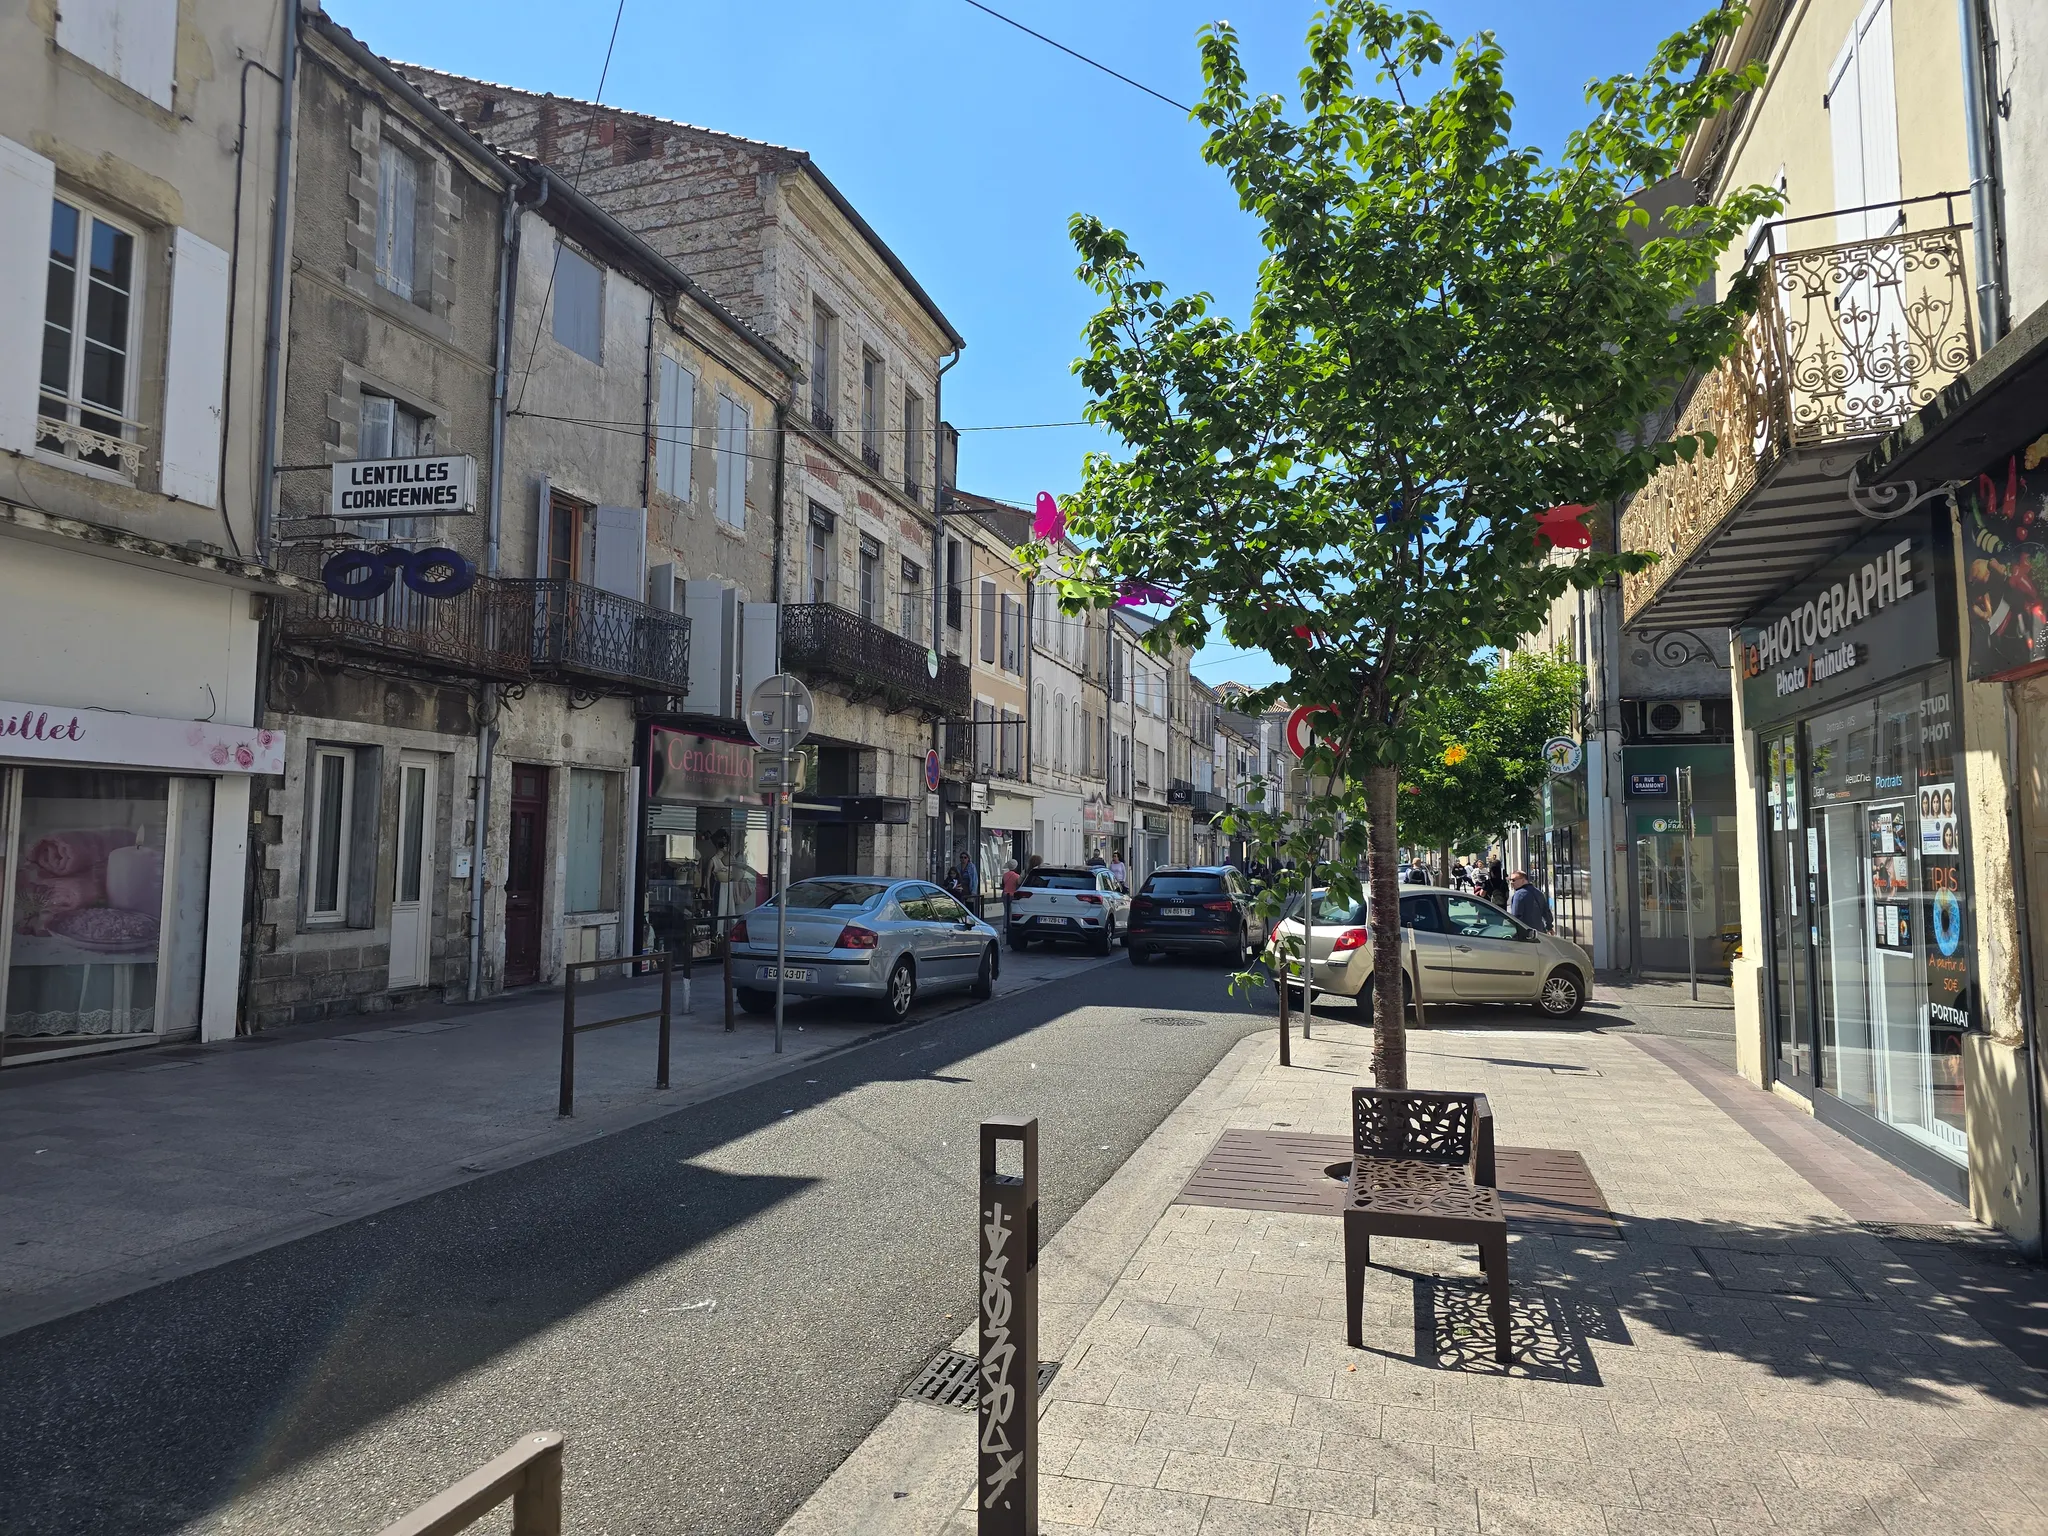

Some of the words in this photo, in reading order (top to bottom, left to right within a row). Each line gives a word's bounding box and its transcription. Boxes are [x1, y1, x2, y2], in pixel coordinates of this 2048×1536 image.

[351, 462, 449, 486] LENTILLES
[341, 485, 458, 510] CORNEENNES
[1740, 642, 1759, 680] Le
[1759, 537, 1914, 671] PHOTOGRAPHE
[1776, 665, 1806, 698] Photo
[1814, 641, 1857, 681] minute
[1919, 694, 1950, 718] STUDI
[1920, 721, 1953, 744] PHOT
[1875, 774, 1903, 790] Portraits
[1931, 866, 1959, 892] IRIS
[1928, 953, 1936, 967] A
[1943, 977, 1960, 993] 50€
